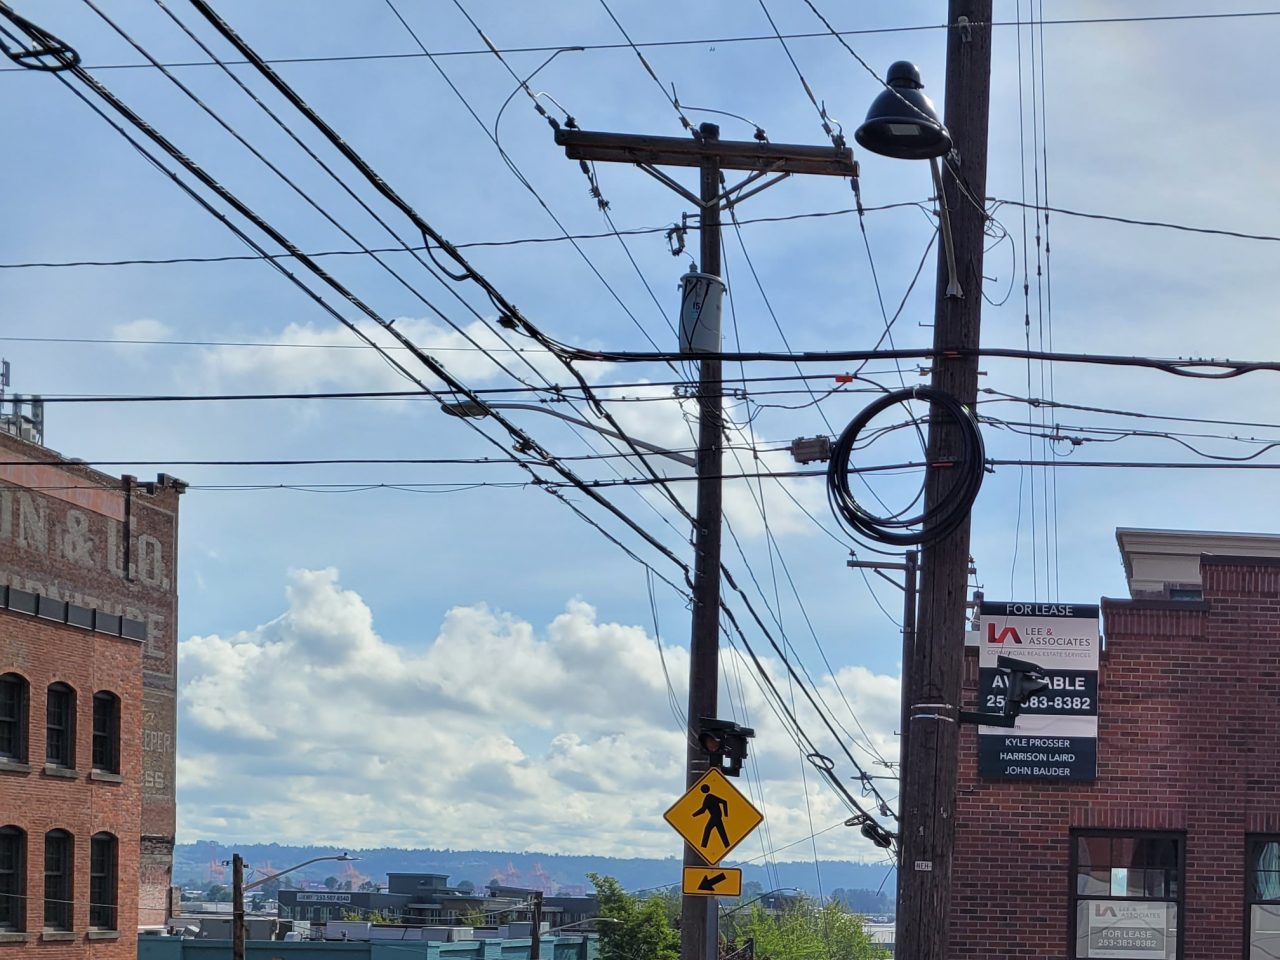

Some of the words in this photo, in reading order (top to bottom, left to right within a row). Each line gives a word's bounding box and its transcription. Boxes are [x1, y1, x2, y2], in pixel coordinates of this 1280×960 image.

[1006, 604, 1032, 615] FOR
[1035, 605, 1074, 616] LEASE
[1025, 627, 1043, 636] LEE
[1046, 627, 1053, 636] &
[1028, 637, 1091, 647] ASSOCIATES
[1005, 738, 1027, 746] KYLE
[1029, 739, 1070, 747] PROSSER
[1000, 752, 1046, 761] HARRISON
[1048, 753, 1075, 762] LAIRD
[1005, 766, 1031, 775] JOHN
[1033, 767, 1070, 776] BAUDER
[1102, 930, 1120, 938] FOR
[1123, 930, 1152, 938] LEASE
